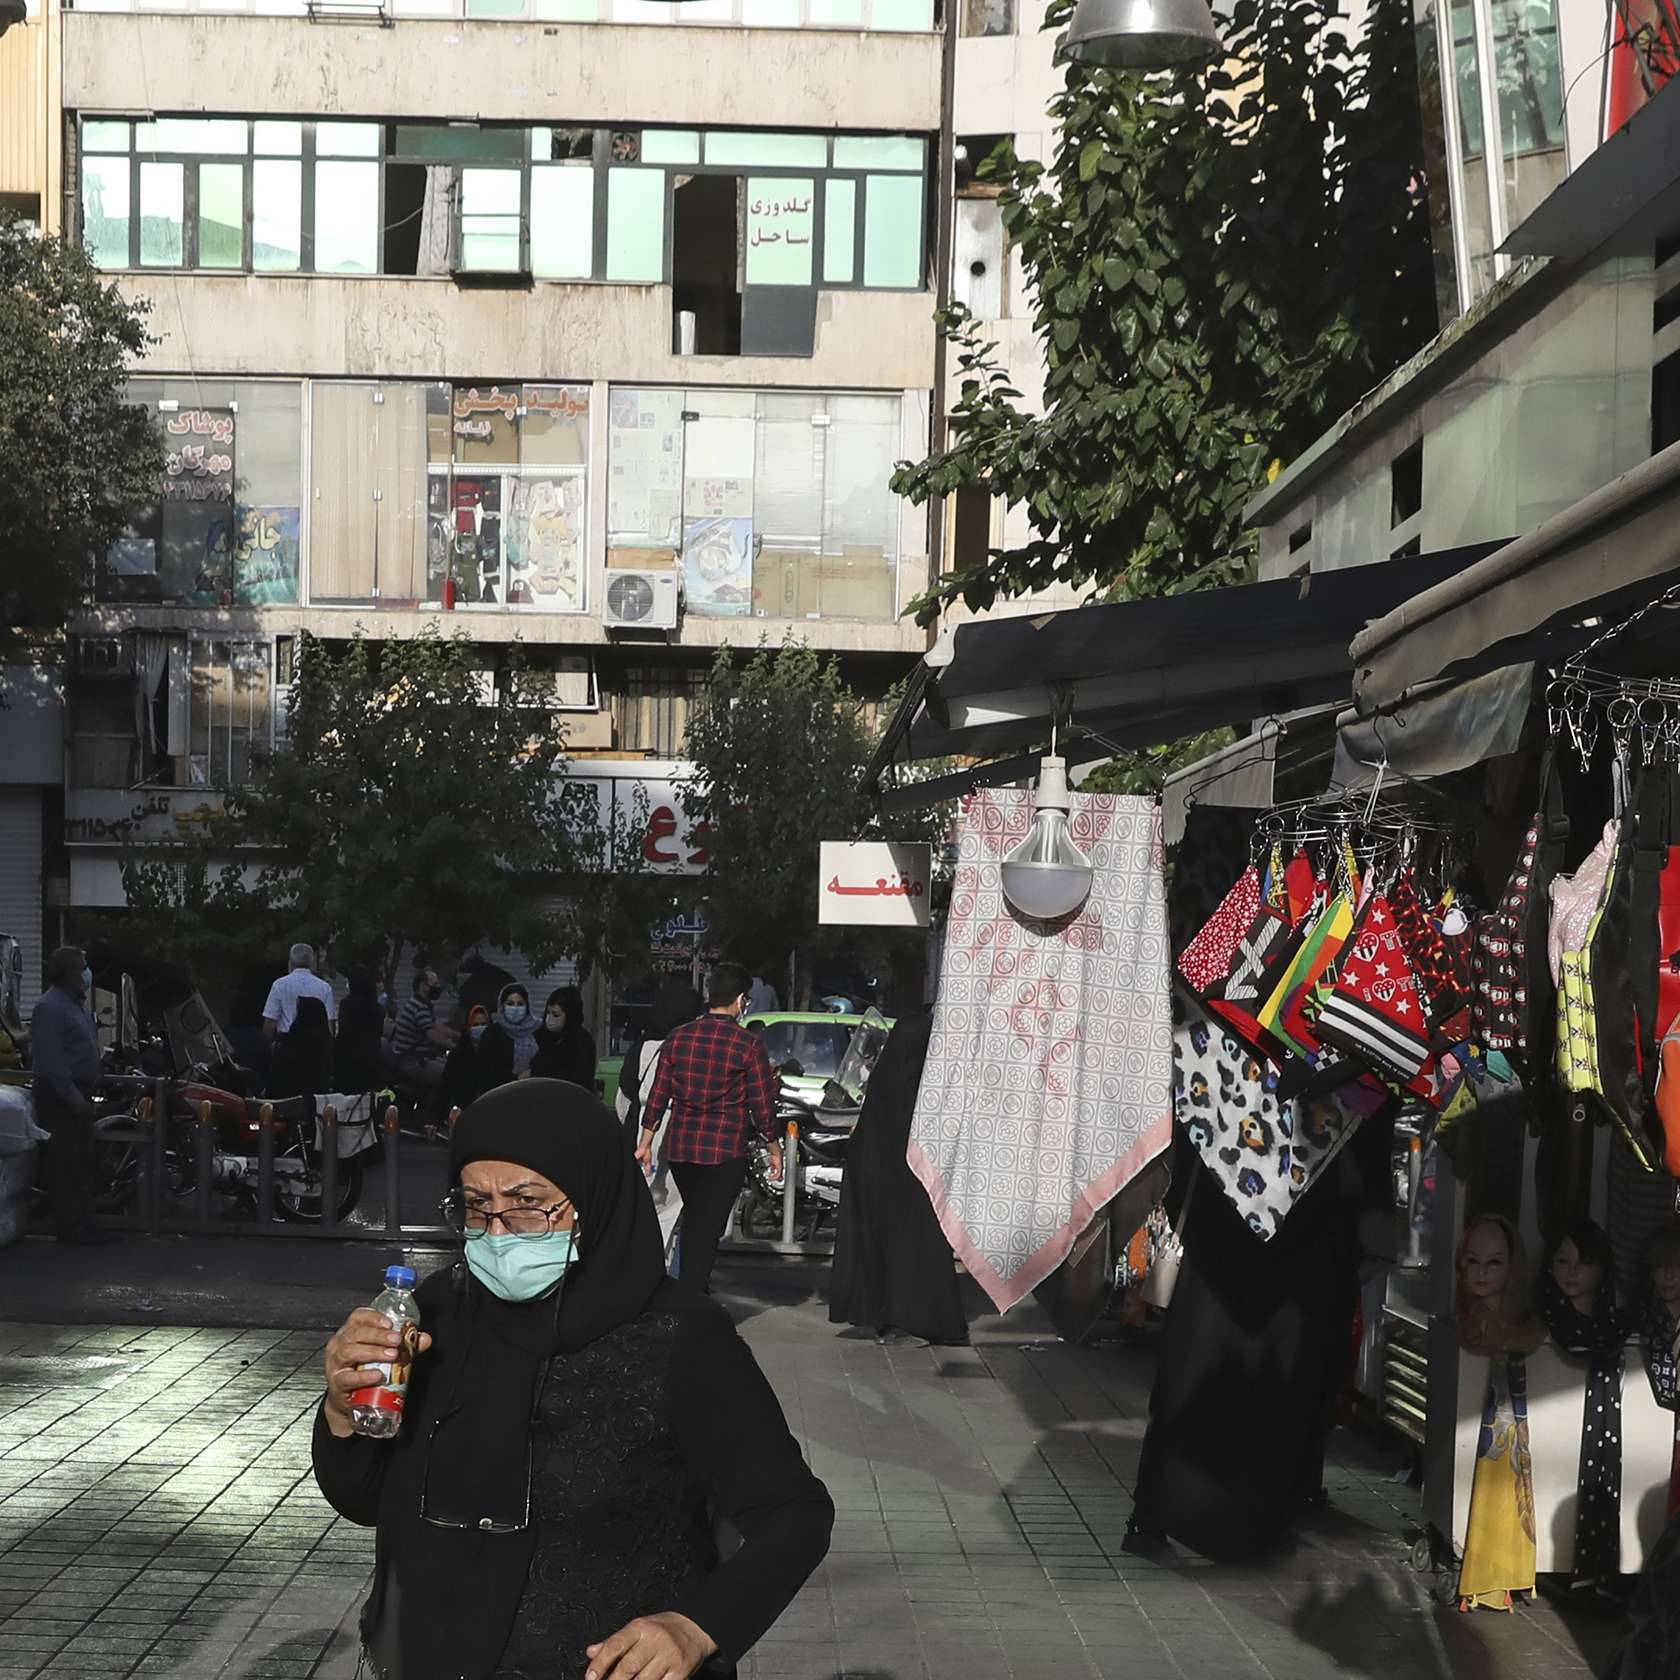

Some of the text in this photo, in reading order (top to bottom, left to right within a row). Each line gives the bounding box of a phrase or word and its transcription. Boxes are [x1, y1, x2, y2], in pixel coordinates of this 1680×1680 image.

[750, 226, 810, 247] ساحل
[453, 385, 519, 421] پخش
[167, 410, 234, 445] پوشاک
[131, 796, 170, 822] تلفن
[827, 871, 923, 897] مقنعه
